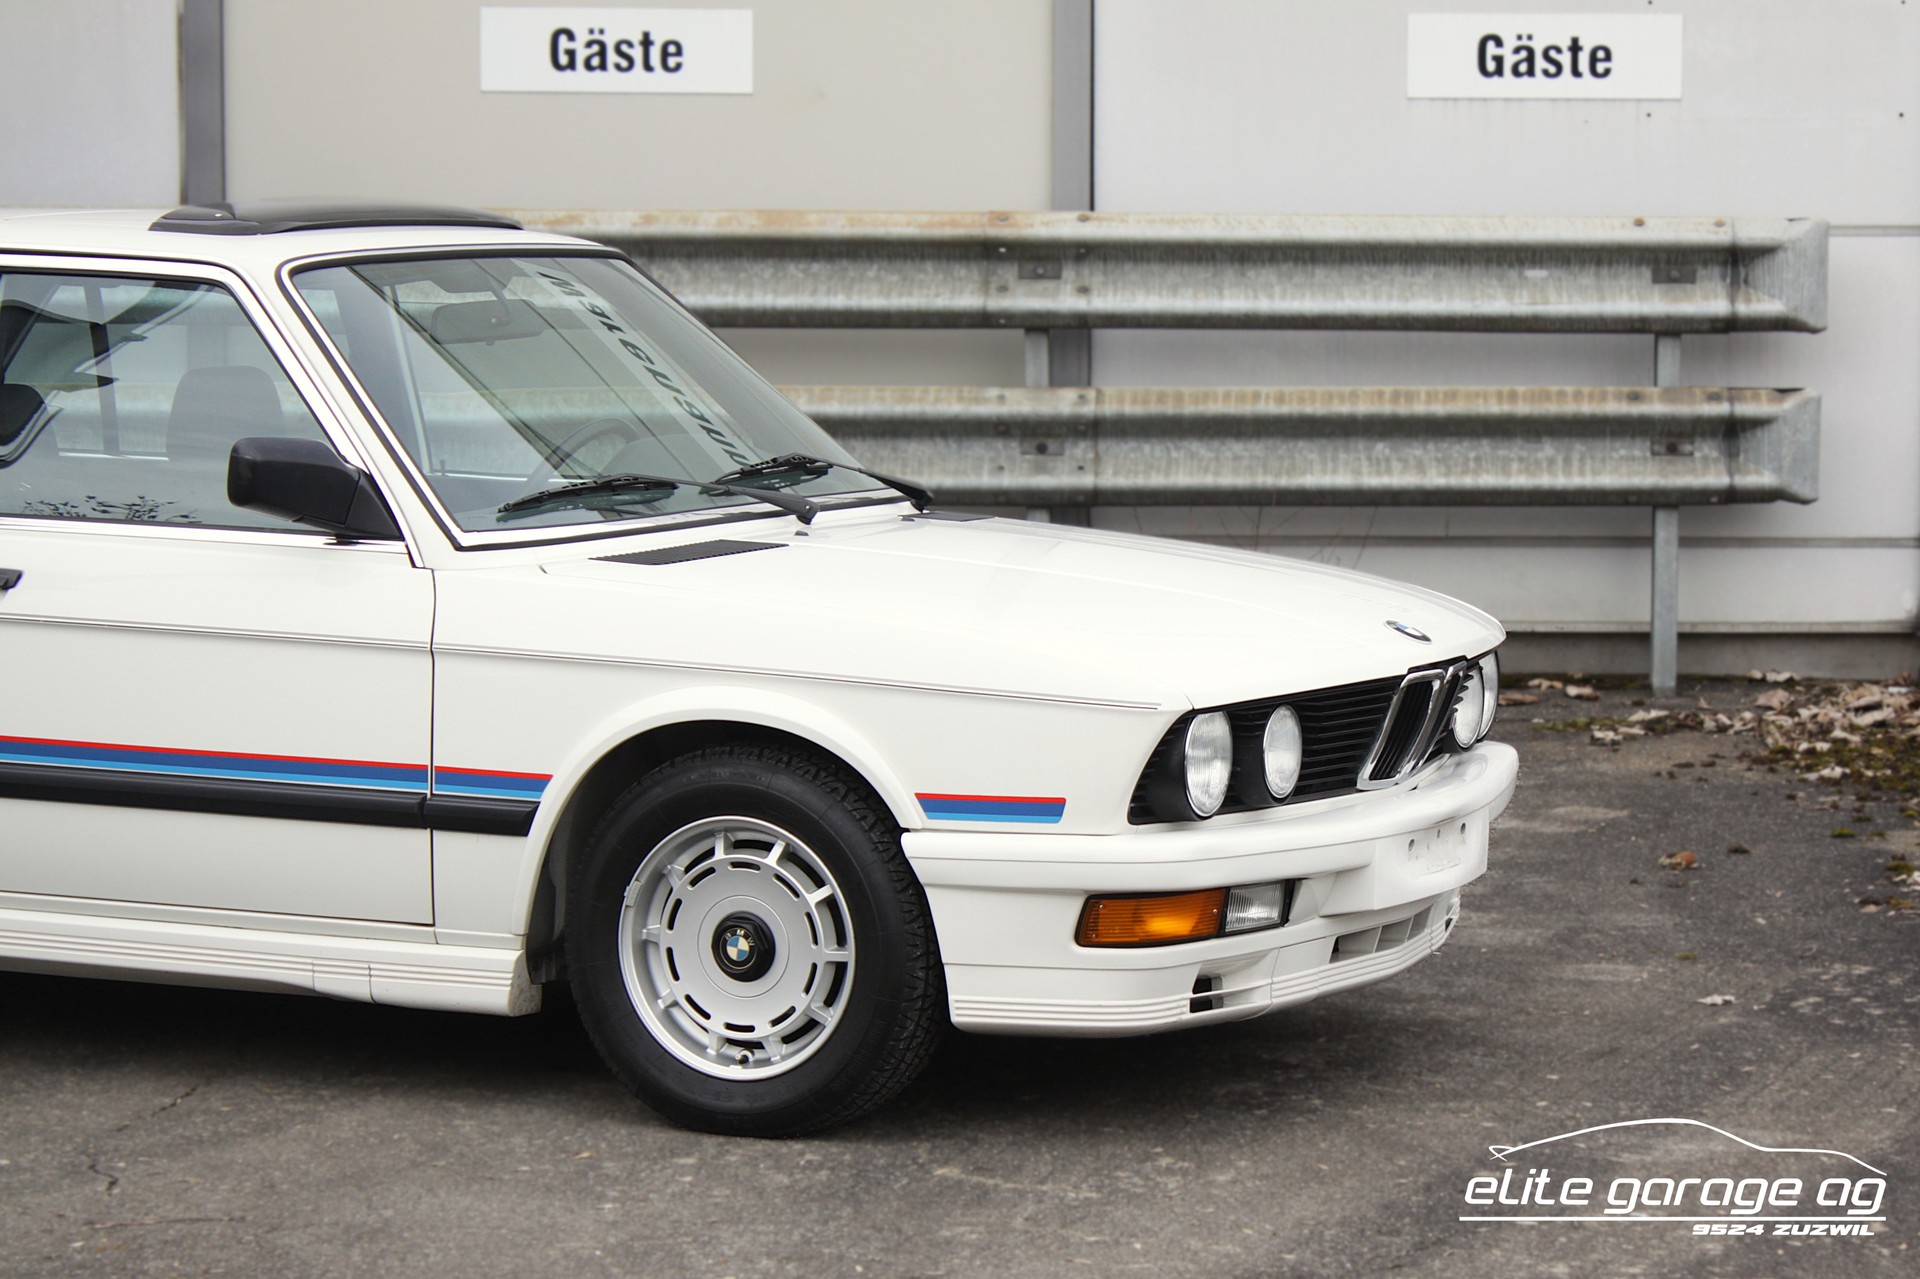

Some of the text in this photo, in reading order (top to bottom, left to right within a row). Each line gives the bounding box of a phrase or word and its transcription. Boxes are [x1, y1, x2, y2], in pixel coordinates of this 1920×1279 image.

[550, 27, 683, 73] Gäste
[1477, 33, 1612, 79] Gäste
[724, 929, 756, 947] BMW
